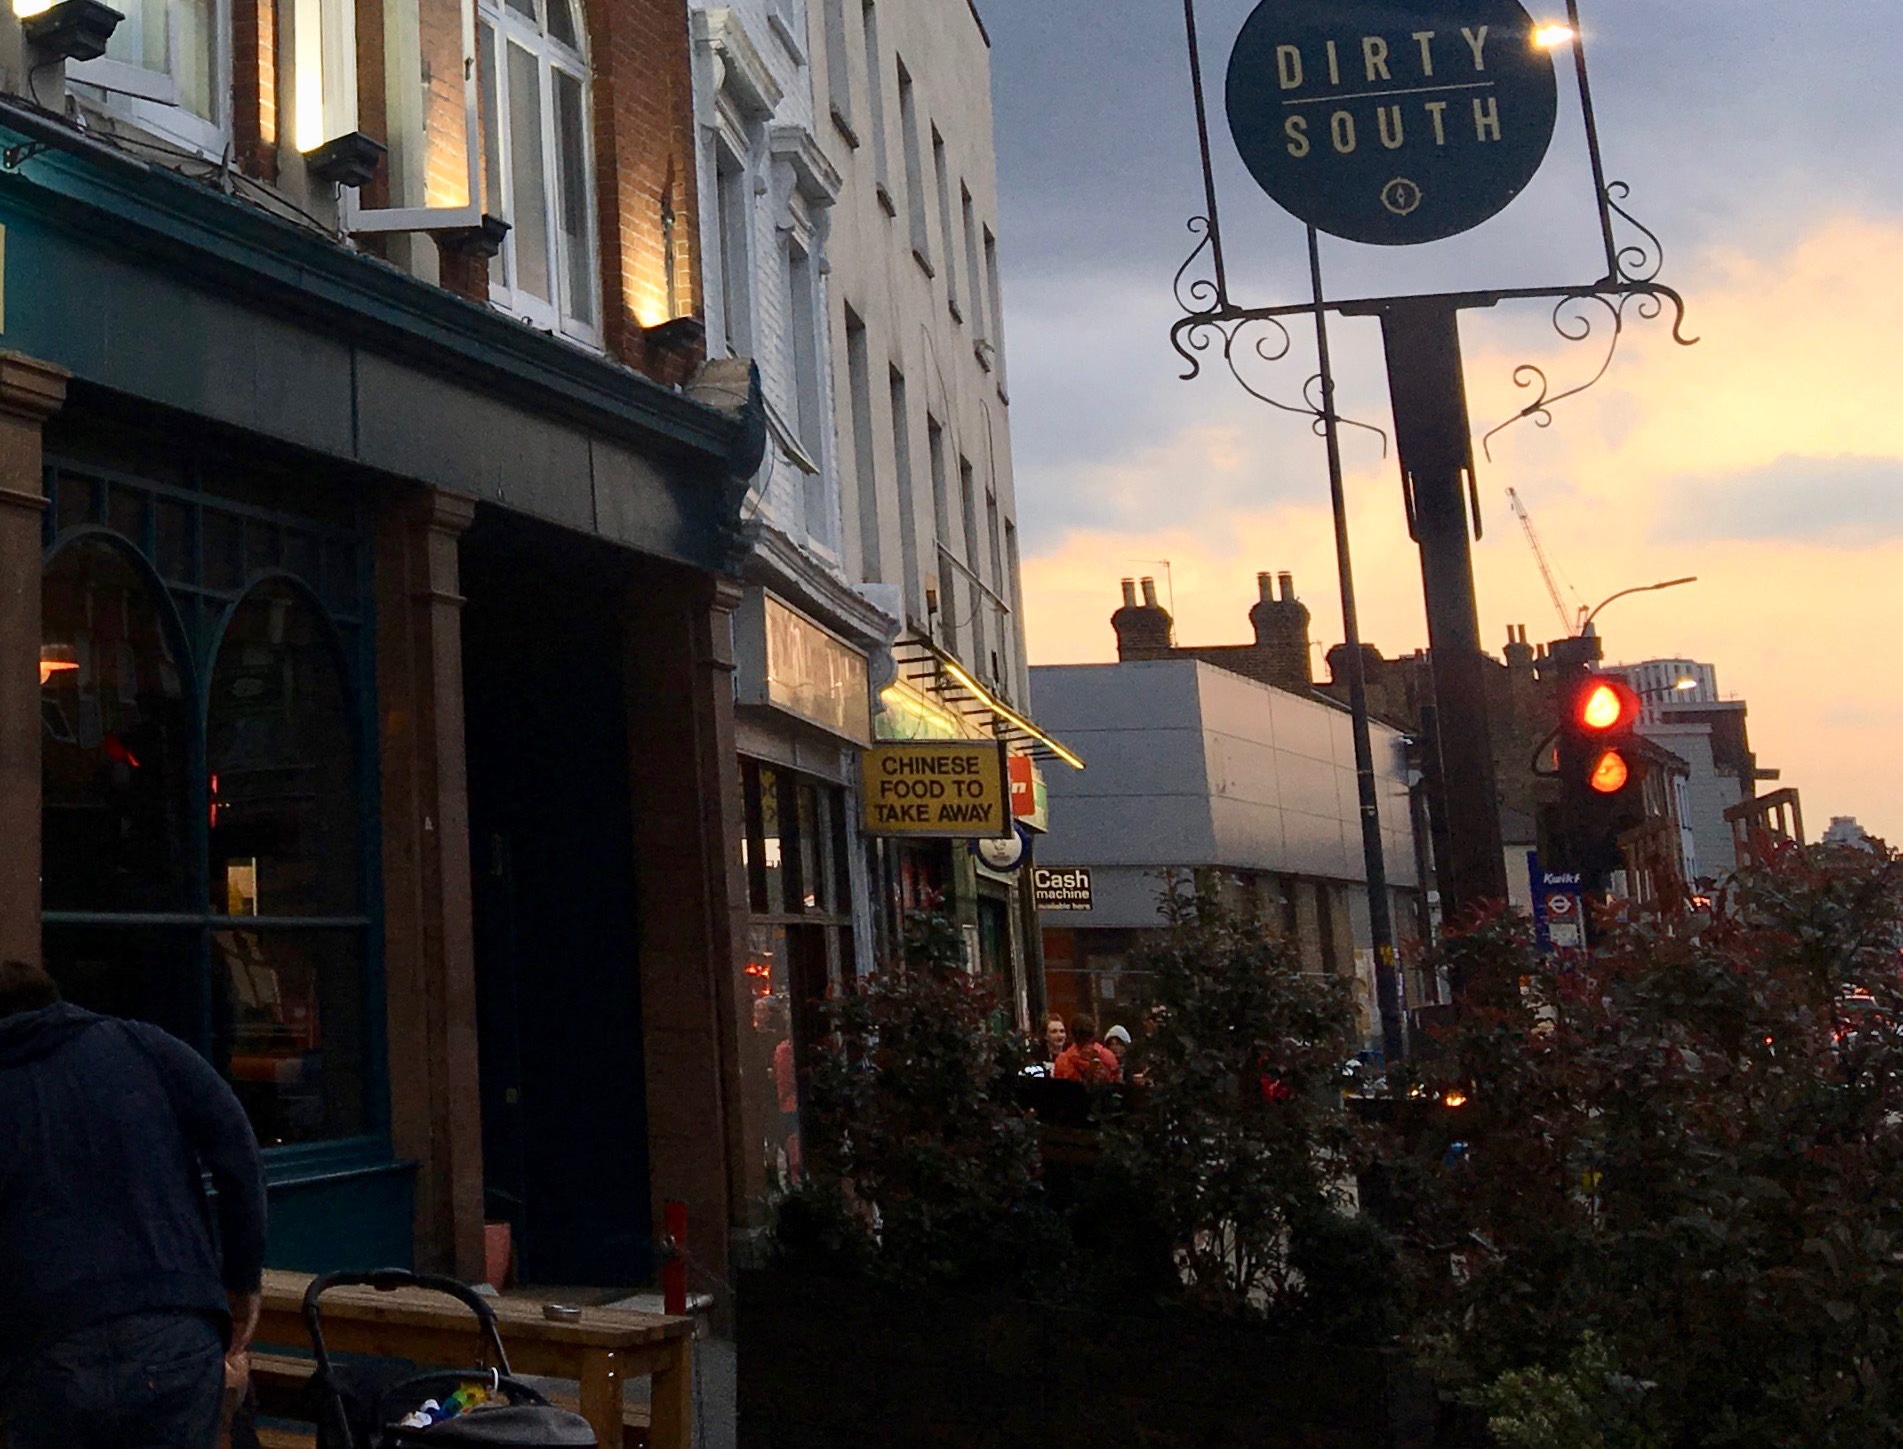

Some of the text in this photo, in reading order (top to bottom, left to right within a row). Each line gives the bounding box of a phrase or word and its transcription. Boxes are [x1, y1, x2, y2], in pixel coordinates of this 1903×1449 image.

[1276, 25, 1488, 90] DIRTY
[1283, 97, 1502, 158] SOUTH
[881, 756, 980, 776] CHINESE
[880, 779, 984, 799] FOOD TO
[873, 803, 993, 823] TAKE AWAY
[1035, 869, 1089, 888] Cash
[1036, 888, 1090, 899] machine
